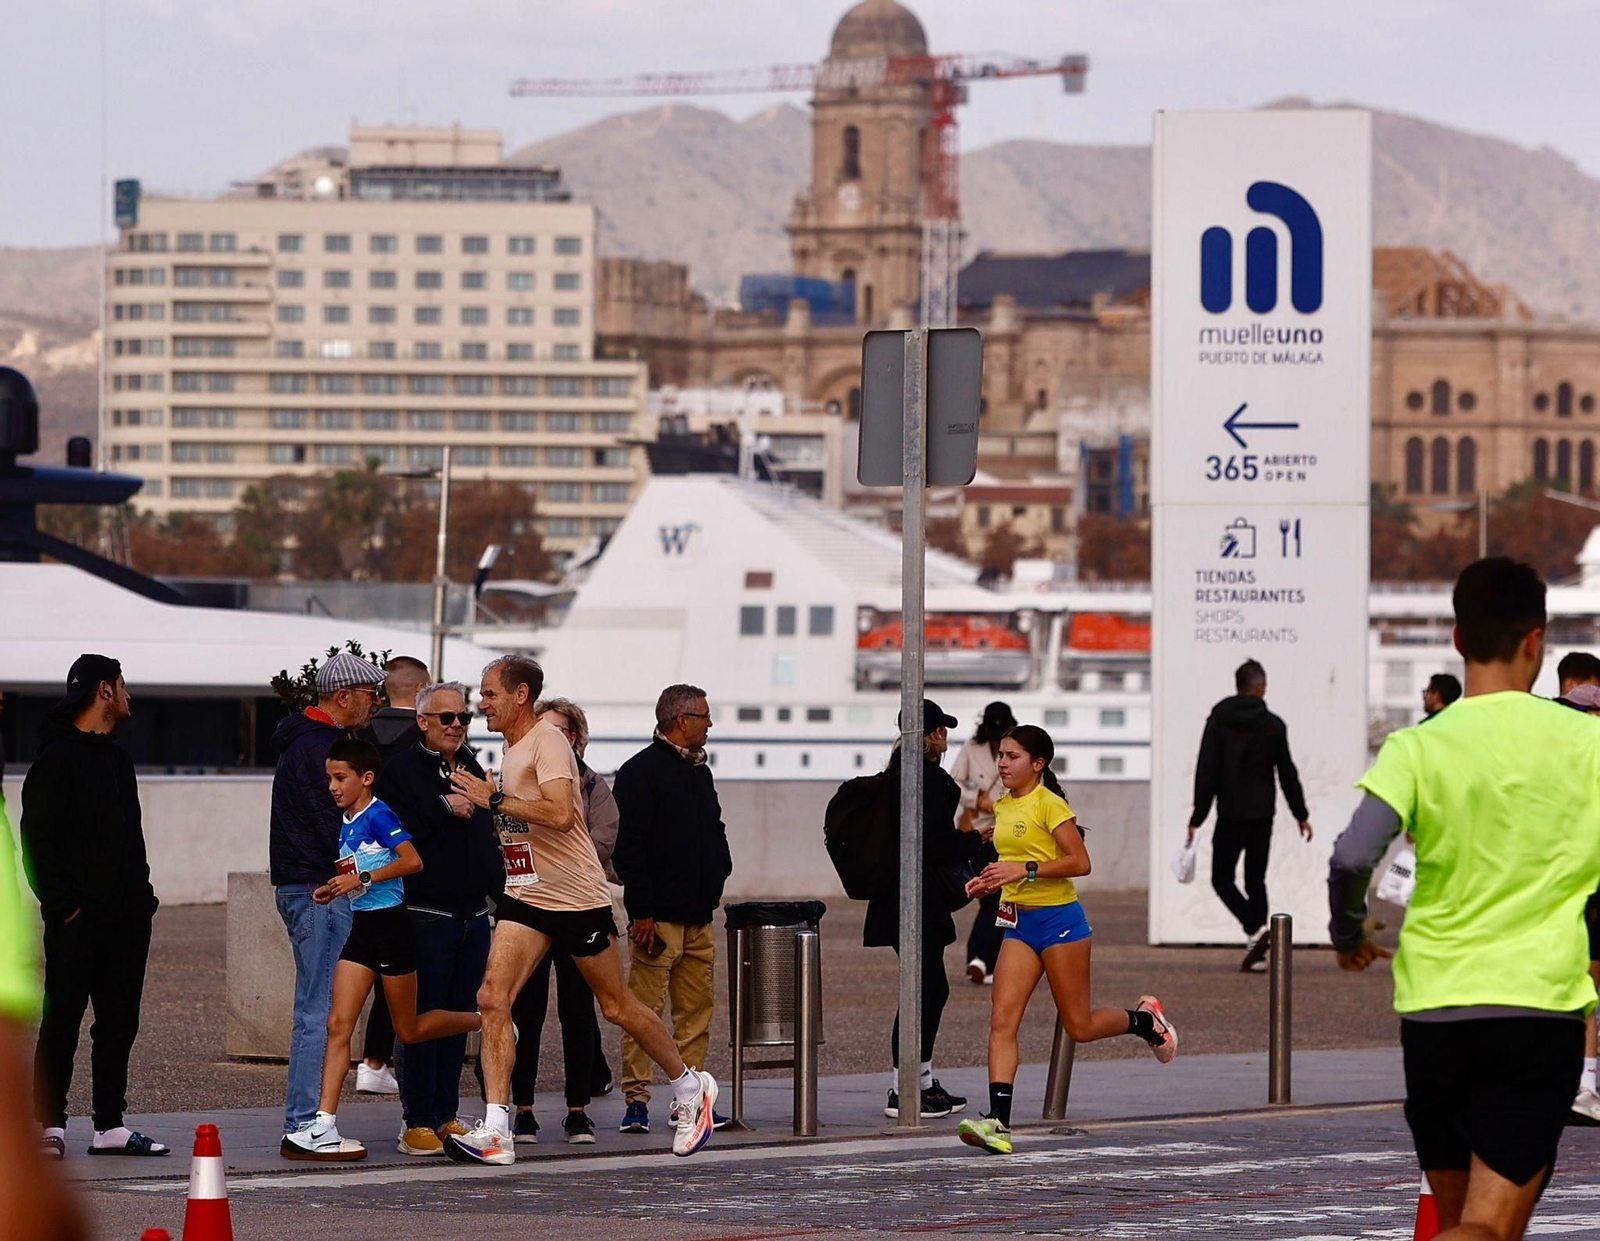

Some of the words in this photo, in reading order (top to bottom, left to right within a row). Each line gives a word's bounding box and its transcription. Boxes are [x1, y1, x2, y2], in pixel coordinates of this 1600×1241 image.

[1199, 322, 1324, 345] muelleuno
[1198, 350, 1249, 365] PUERTO
[1252, 350, 1268, 365] DE
[1272, 348, 1324, 365] MÁLAGA
[1205, 455, 1259, 482] 365
[1263, 455, 1318, 467] ABIERTO
[1264, 470, 1307, 482] OPEN
[1194, 570, 1256, 584] TIENDAS
[1195, 589, 1305, 603] RESTAURANTES
[1194, 609, 1245, 624] SHOPS
[1194, 628, 1298, 643] RESTAURANTS
